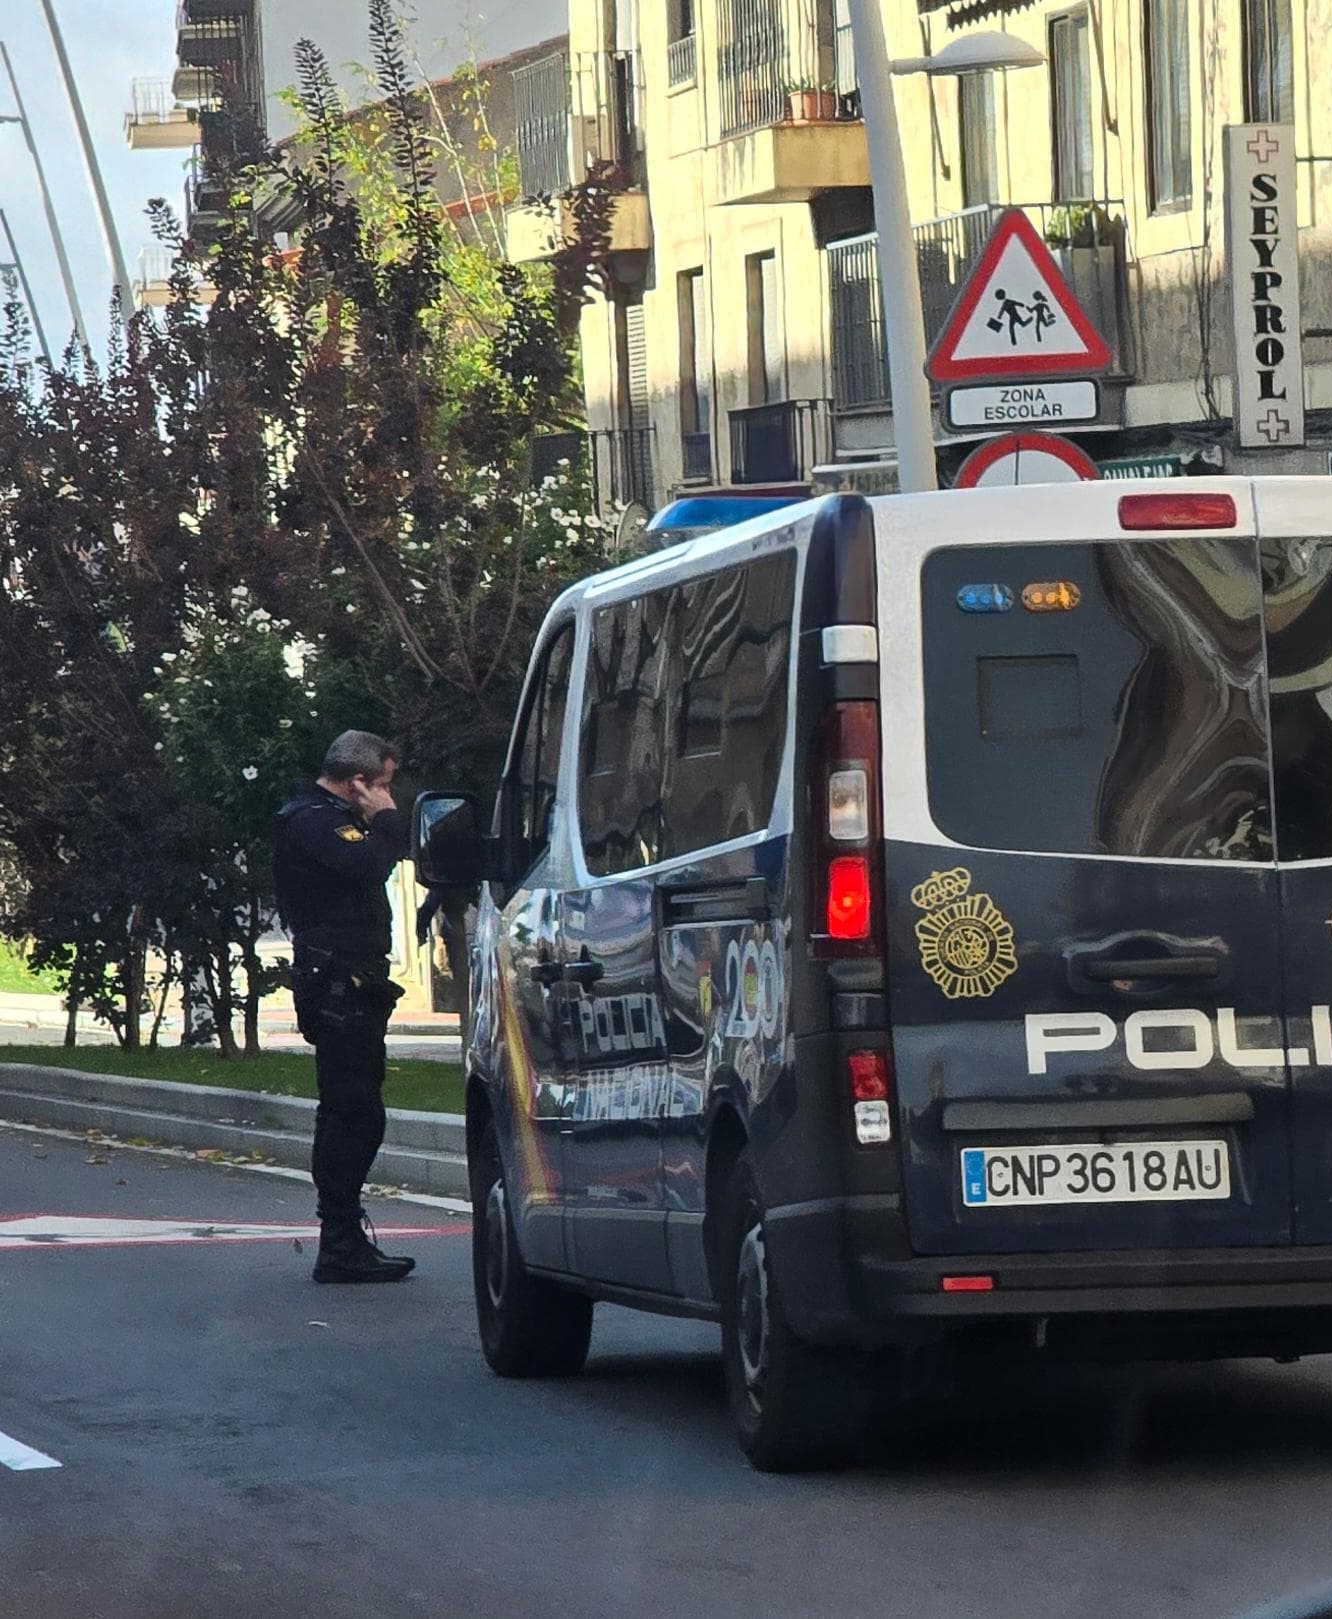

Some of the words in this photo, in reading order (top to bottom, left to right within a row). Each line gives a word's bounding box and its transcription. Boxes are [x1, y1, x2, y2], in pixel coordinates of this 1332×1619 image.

[1250, 172, 1287, 401] SEYPROL
[1001, 388, 1046, 403] ZONA
[984, 403, 1063, 420] ESCOLAR
[971, 1182, 982, 1196] E
